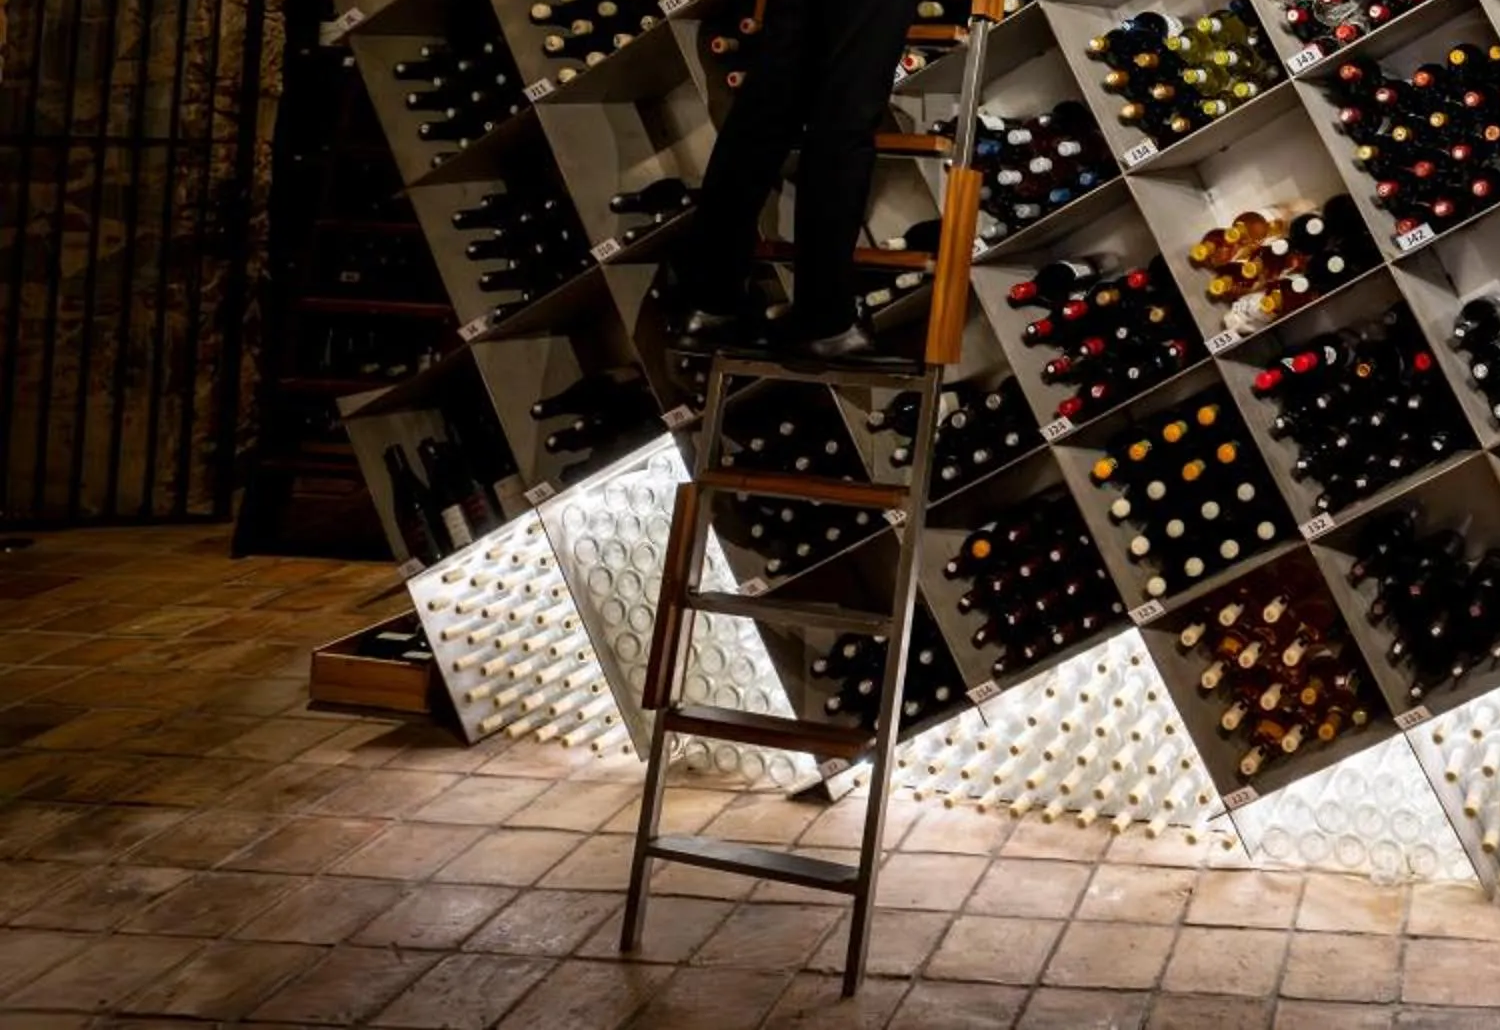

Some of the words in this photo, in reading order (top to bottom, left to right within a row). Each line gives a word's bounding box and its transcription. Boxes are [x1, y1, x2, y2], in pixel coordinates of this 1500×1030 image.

[1296, 51, 1315, 67] J43
[1132, 147, 1150, 161] J34
[1407, 230, 1426, 246] J42
[1213, 333, 1233, 348] J33
[1308, 518, 1326, 533] J32
